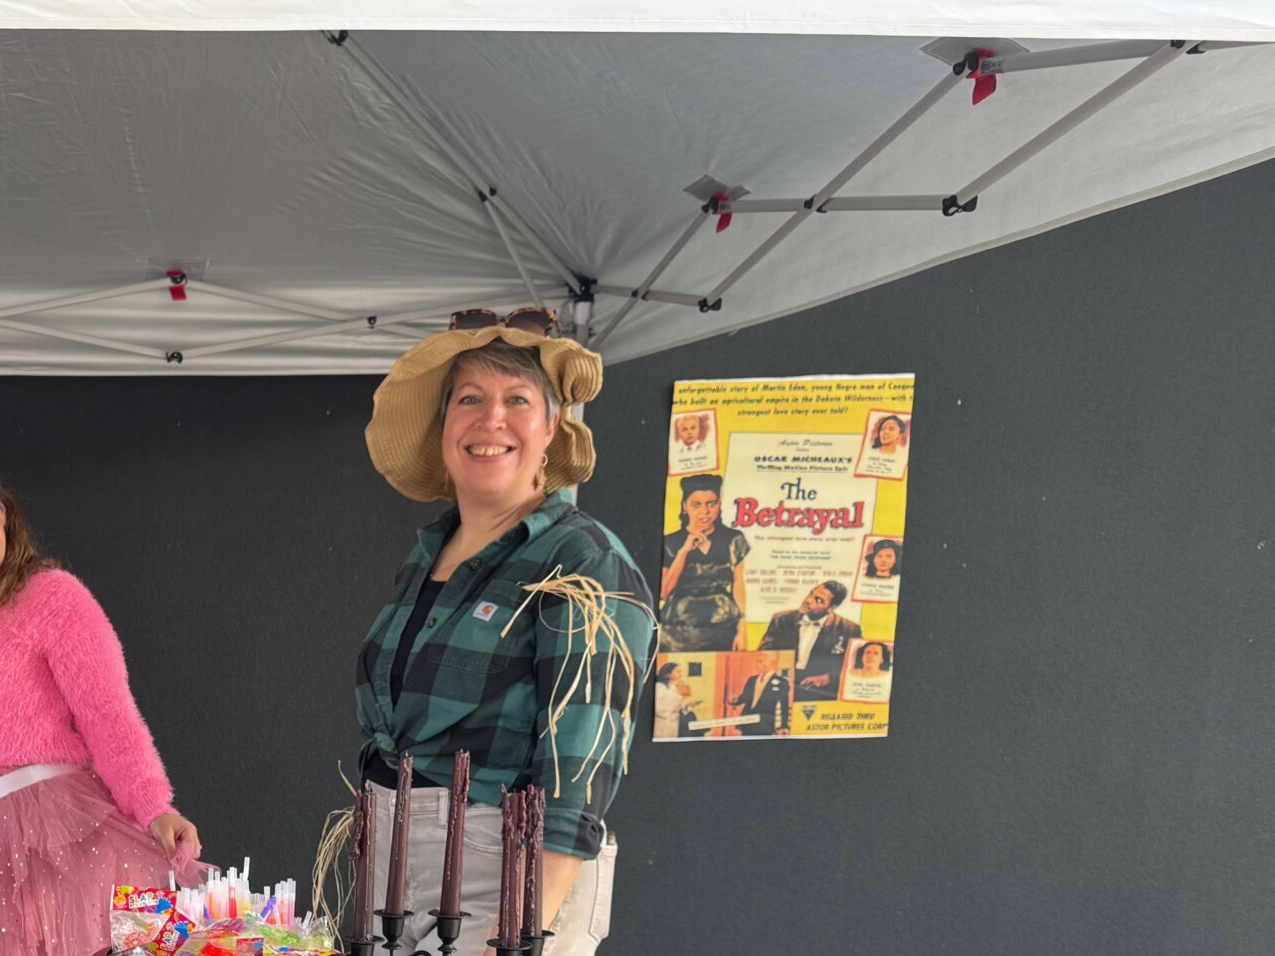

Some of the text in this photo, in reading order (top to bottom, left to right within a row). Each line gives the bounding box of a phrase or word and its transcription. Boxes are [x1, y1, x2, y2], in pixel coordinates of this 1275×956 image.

[678, 385, 726, 395] unforgettable
[729, 385, 749, 394] story
[751, 384, 759, 392] of
[762, 383, 786, 392] Martin
[811, 384, 833, 393] young
[836, 383, 857, 392] Negro
[878, 382, 885, 390] of
[691, 397, 706, 405] built
[722, 396, 763, 407] agricultural
[766, 397, 789, 406] empire
[803, 395, 813, 403] the
[816, 395, 840, 403] Dakota
[738, 409, 771, 417] strangest
[773, 408, 788, 416] love
[791, 456, 853, 464] MICHEAUX'S
[780, 477, 817, 501] The
[731, 497, 865, 535] Betrayal
[821, 713, 854, 721] RELEASED
[831, 723, 865, 731] PICTURES
